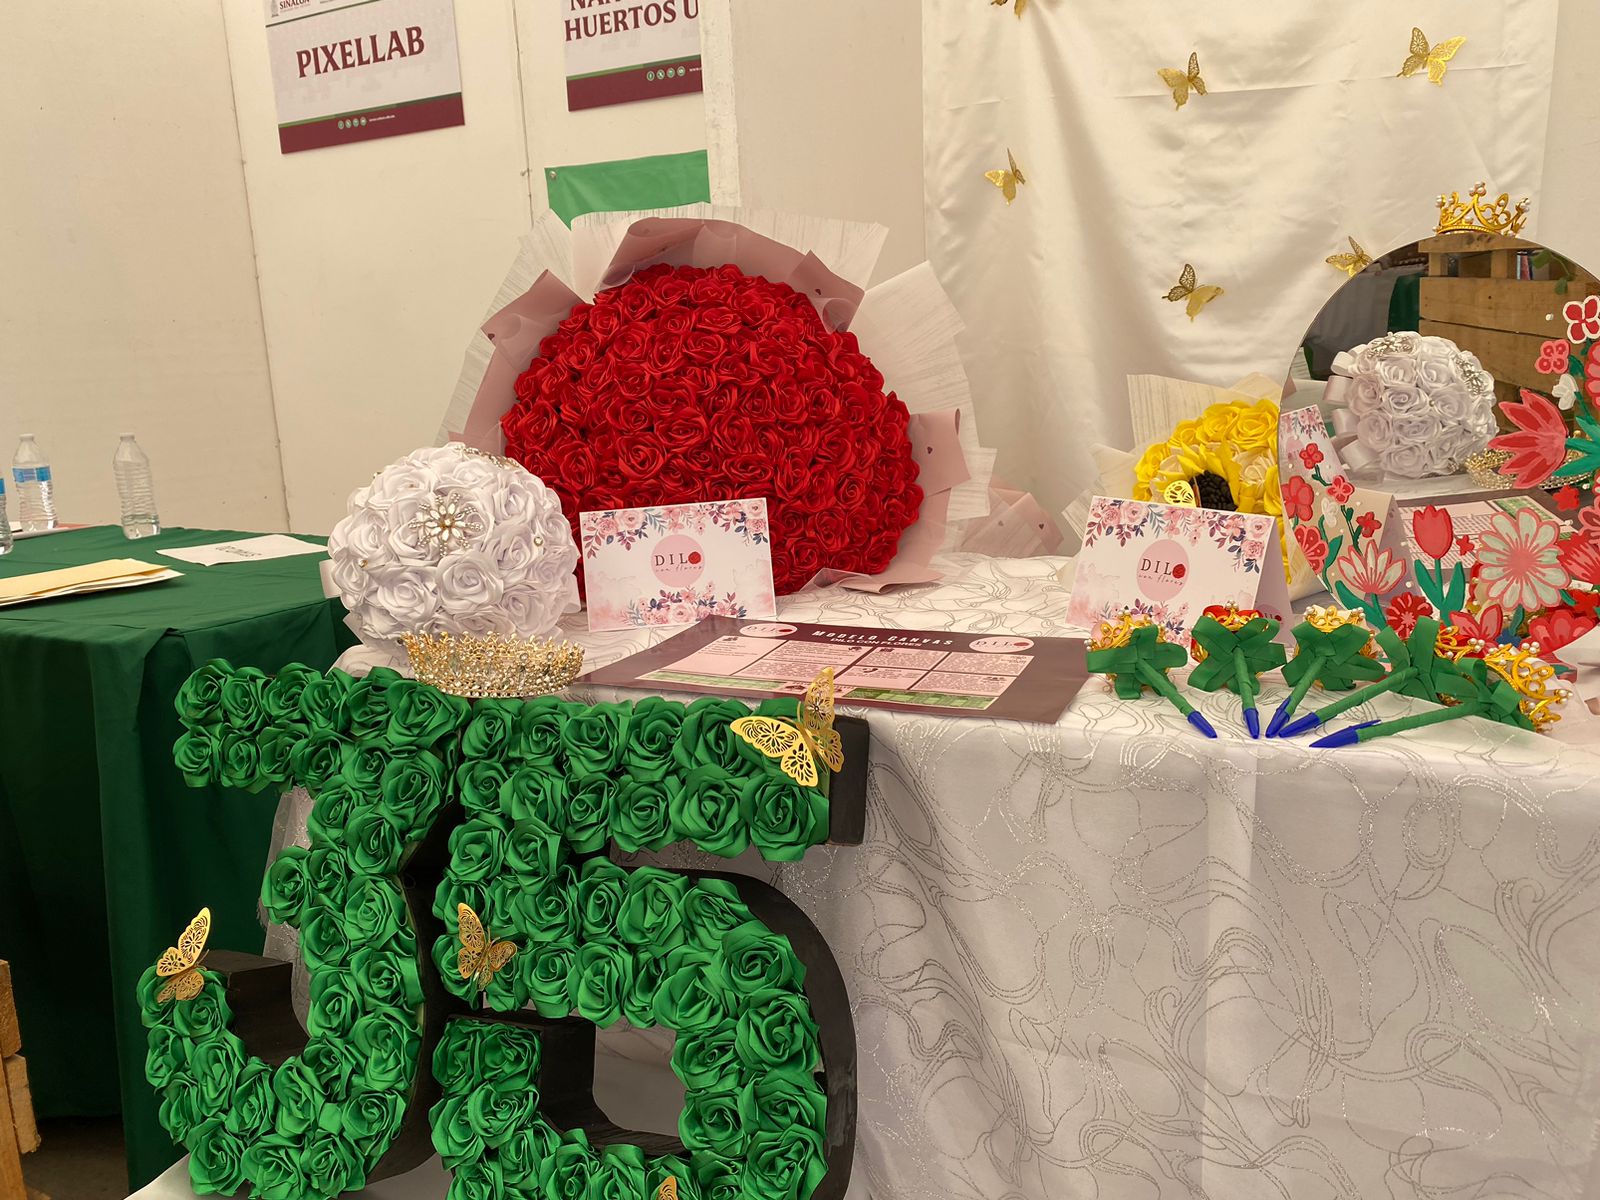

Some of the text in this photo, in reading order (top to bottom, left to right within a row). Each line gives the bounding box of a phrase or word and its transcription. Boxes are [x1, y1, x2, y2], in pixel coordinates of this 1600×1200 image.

[564, 0, 677, 42] HUERTOS
[296, 26, 425, 78] PIXELLAB
[811, 630, 954, 646] MODELO CANVAS
